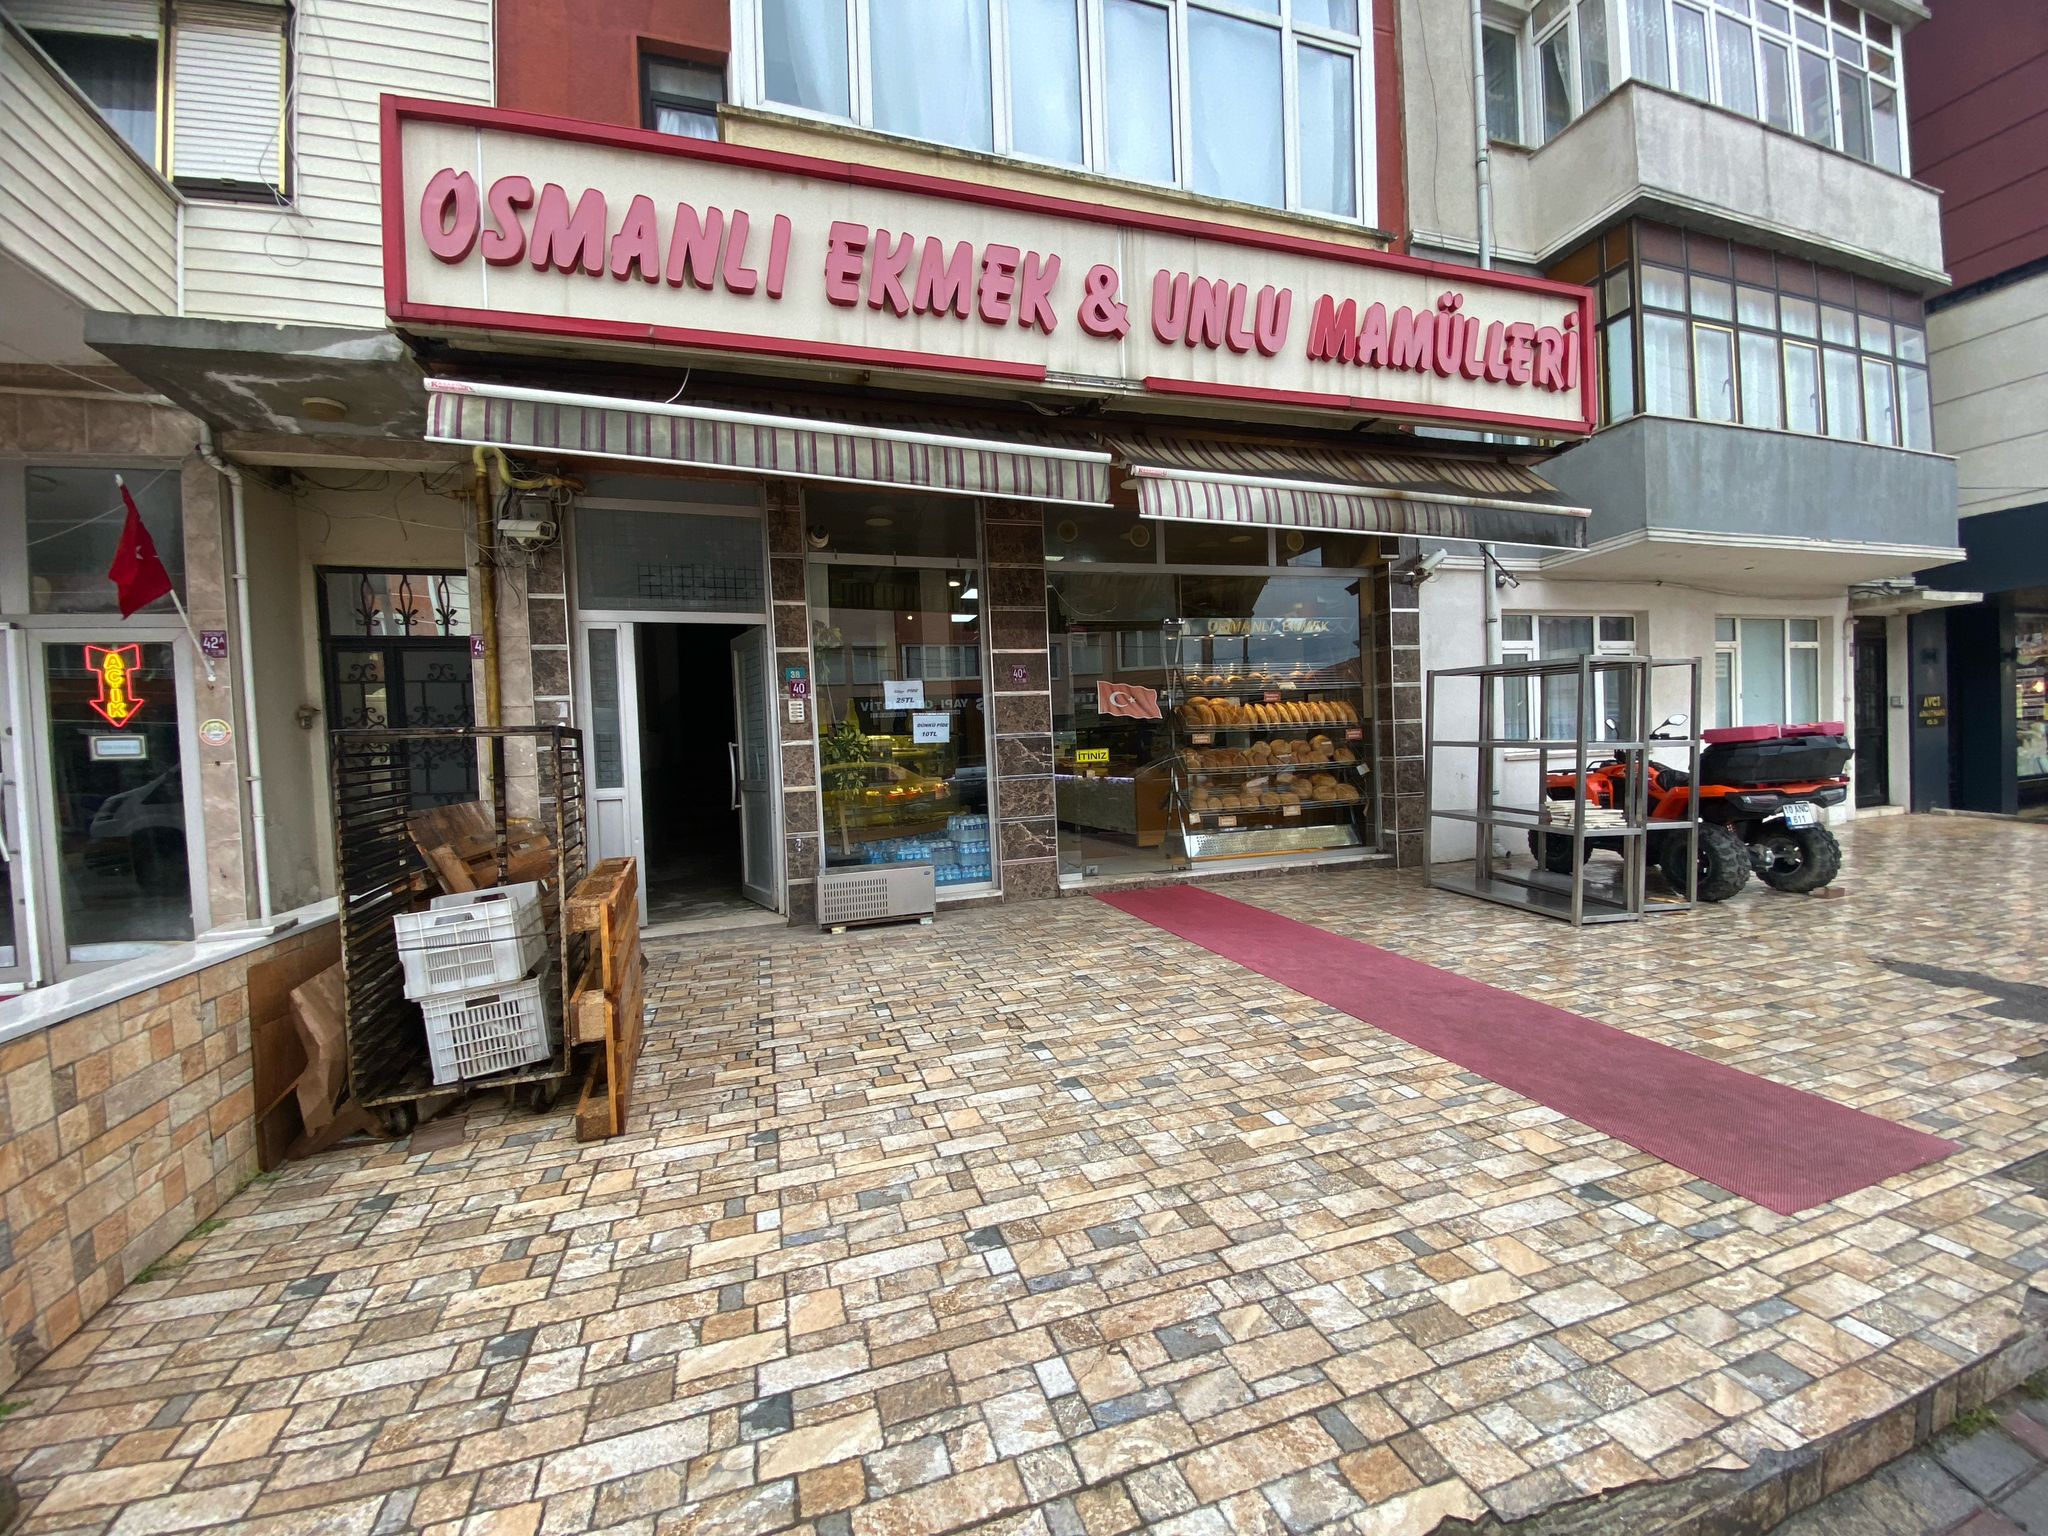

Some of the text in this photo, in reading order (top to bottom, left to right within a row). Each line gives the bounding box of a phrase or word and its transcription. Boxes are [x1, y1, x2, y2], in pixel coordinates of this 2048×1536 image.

[419, 166, 1580, 393] OSMANLI EKMEK & UNLU MAMÜLLERİ
[103, 652, 128, 719] AÇIK
[790, 670, 801, 679] 38
[792, 683, 806, 694] 40
